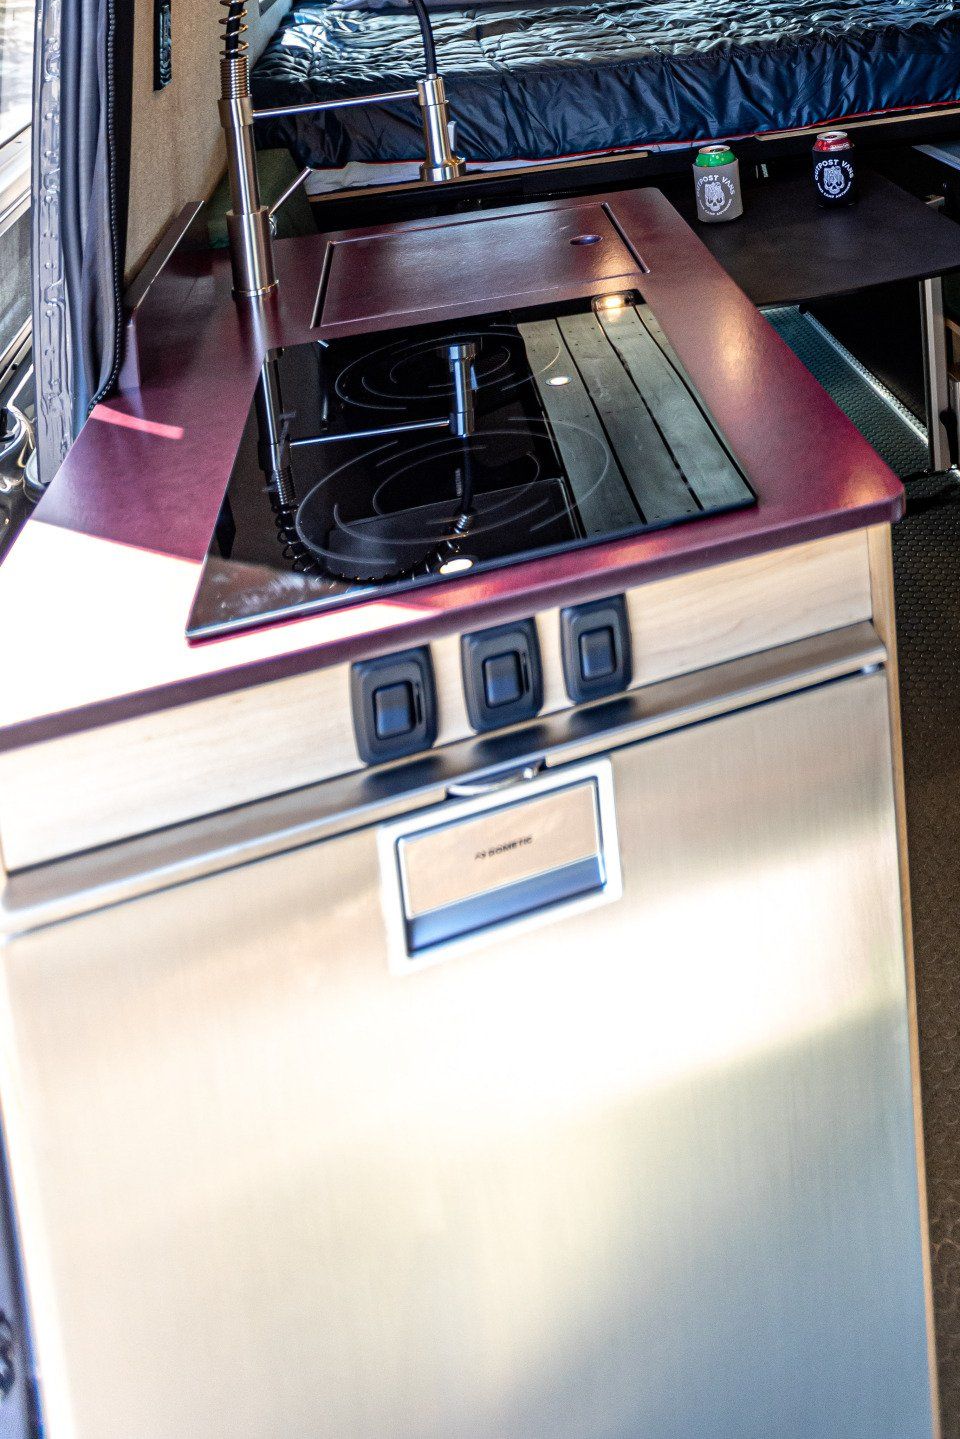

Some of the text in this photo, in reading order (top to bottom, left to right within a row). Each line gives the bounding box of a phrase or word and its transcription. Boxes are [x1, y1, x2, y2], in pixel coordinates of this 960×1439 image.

[815, 159, 854, 180] OUTPOST VANS
[697, 175, 736, 197] OUTPOST VANS
